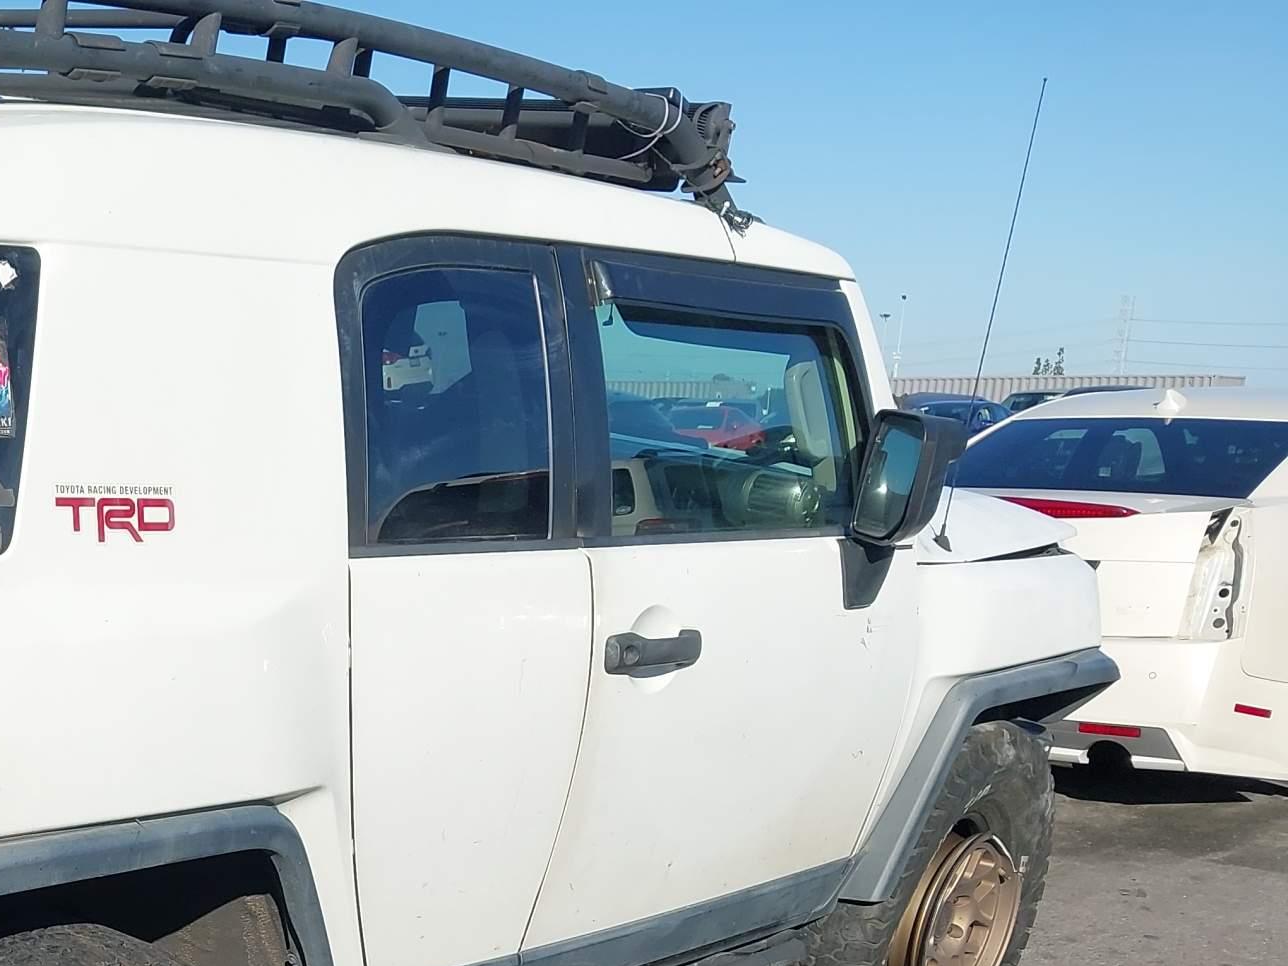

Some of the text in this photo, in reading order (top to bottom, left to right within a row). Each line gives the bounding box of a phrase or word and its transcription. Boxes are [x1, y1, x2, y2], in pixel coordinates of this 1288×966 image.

[55, 484, 173, 496] TOYOTA RACING DEVELOPMENT
[55, 497, 176, 542] TRD
